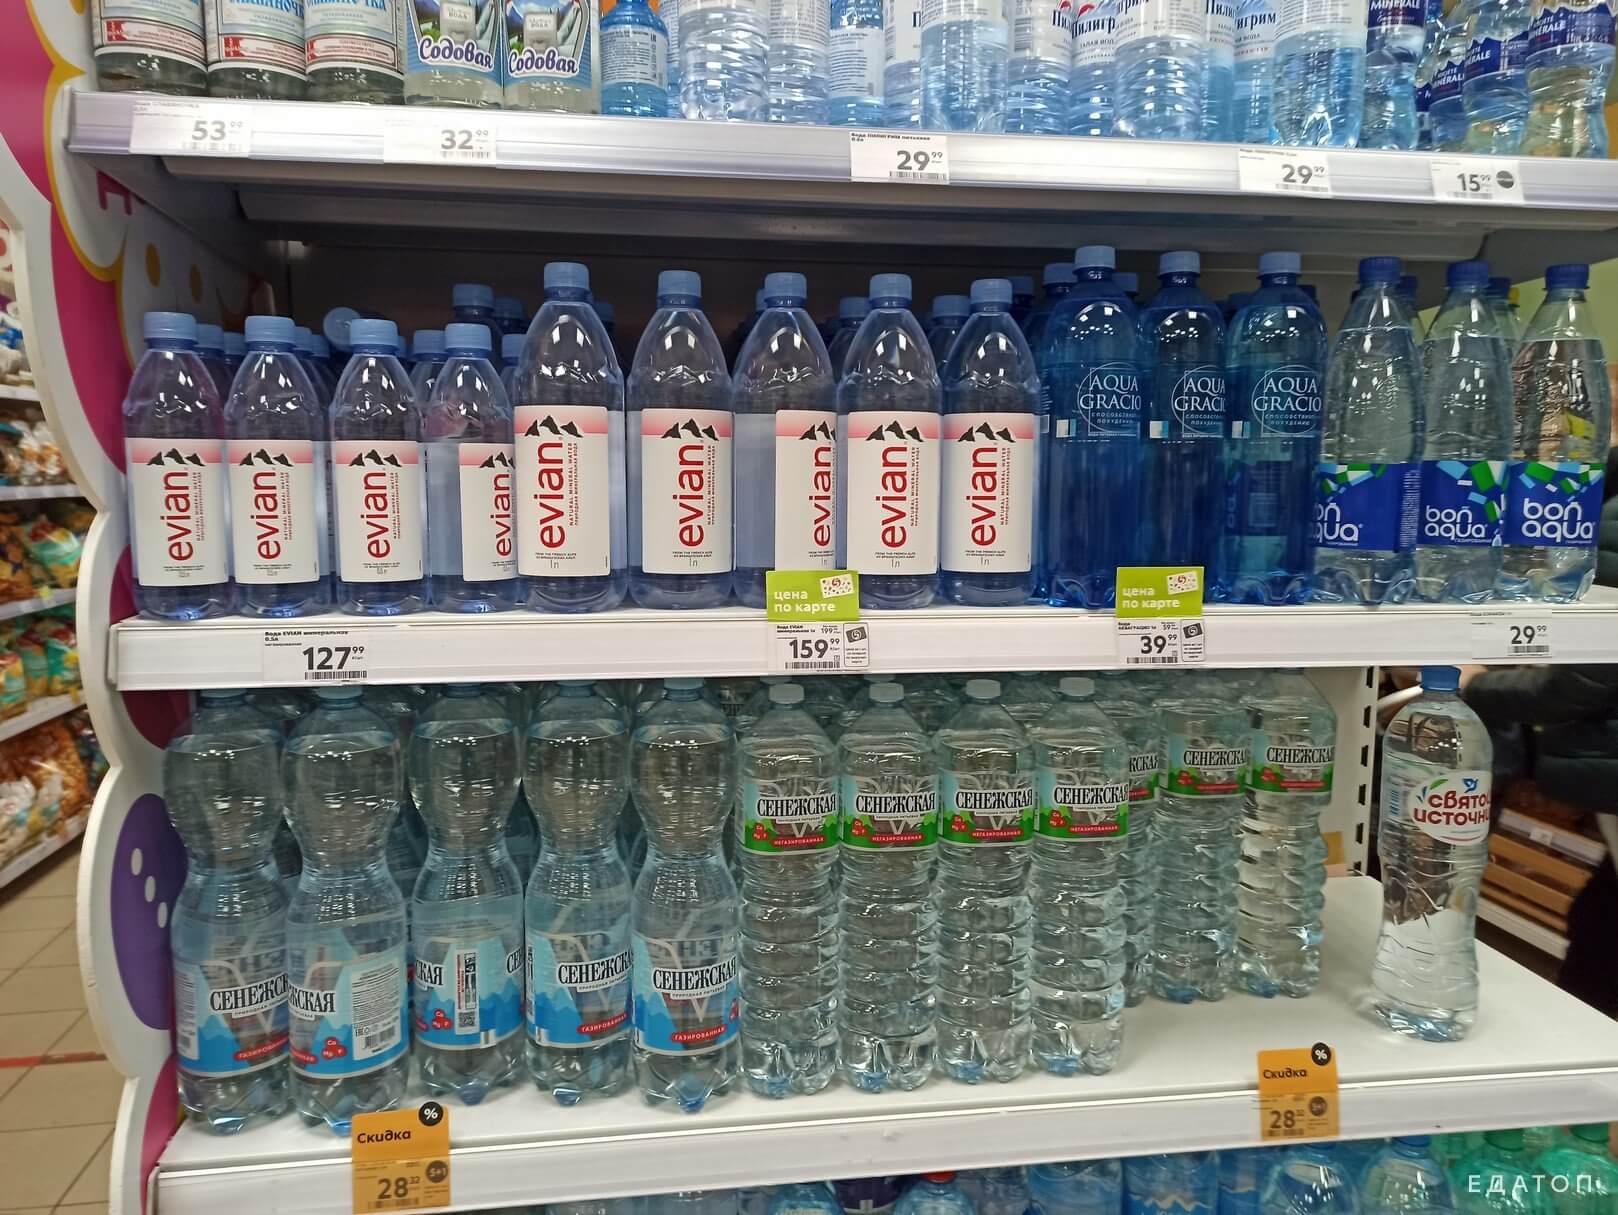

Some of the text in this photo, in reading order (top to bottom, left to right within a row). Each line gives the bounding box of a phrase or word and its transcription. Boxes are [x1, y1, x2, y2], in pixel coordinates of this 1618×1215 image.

[419, 37, 493, 69] Содовая
[509, 49, 578, 74] Содовая
[192, 120, 226, 141] 53
[441, 129, 474, 150] 32
[897, 150, 930, 171] 29
[1281, 164, 1313, 184] 29
[1457, 173, 1480, 192] 15
[1090, 375, 1138, 394] AQUA
[1184, 377, 1226, 396] AQUA
[1264, 377, 1318, 396] AQUA
[1079, 394, 1142, 410] GRACIO
[1254, 396, 1322, 412] GRACIO
[534, 442, 566, 549] evian
[672, 443, 705, 548] evian
[808, 446, 832, 547] evian
[875, 446, 908, 548] evian
[966, 447, 998, 547] evian
[160, 471, 194, 561] evian
[250, 471, 281, 560] evian
[360, 472, 391, 559] evian
[490, 473, 512, 557] evian
[1424, 522, 1486, 541] aqua
[1521, 520, 1593, 543] aqua
[773, 591, 808, 602] цена
[1122, 588, 1155, 598] цена
[774, 603, 836, 614] по карте
[1122, 600, 1181, 610] по карте
[1140, 635, 1167, 654] 39
[1510, 625, 1536, 644] 29
[302, 646, 365, 670] 127 99
[789, 639, 828, 659] 159
[757, 794, 836, 816] СЕНЕЖСКАЯ
[856, 793, 936, 814] СЕНЕЖСКАЯ
[956, 789, 1033, 809] СЕНЕЖСКАЯ
[653, 956, 736, 990] СЕНЕЖСКАЯ
[1315, 1049, 1328, 1060] %
[1263, 1068, 1308, 1080] Скидка
[424, 1108, 439, 1120] %
[1270, 1110, 1296, 1129] 28
[357, 1129, 412, 1144] Скидка
[377, 1177, 409, 1200] 28
